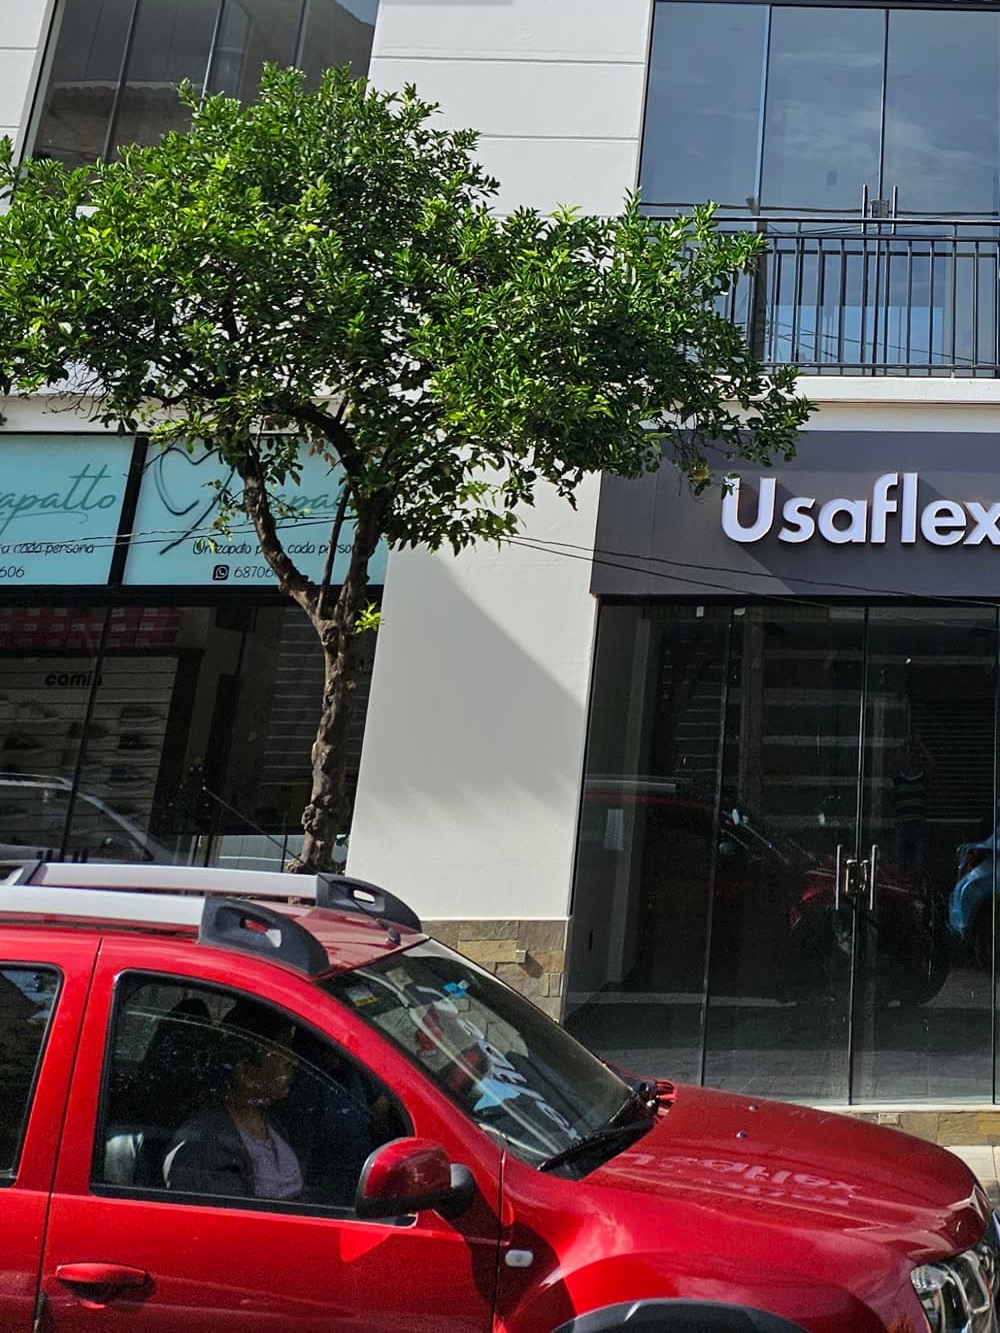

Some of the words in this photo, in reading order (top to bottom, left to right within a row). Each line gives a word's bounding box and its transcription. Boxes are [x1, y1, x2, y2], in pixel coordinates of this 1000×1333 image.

[0, 463, 116, 536] apatto
[44, 544, 95, 556] persona
[215, 541, 252, 556] zapato
[287, 541, 316, 555] cada
[234, 565, 275, 579] 68706
